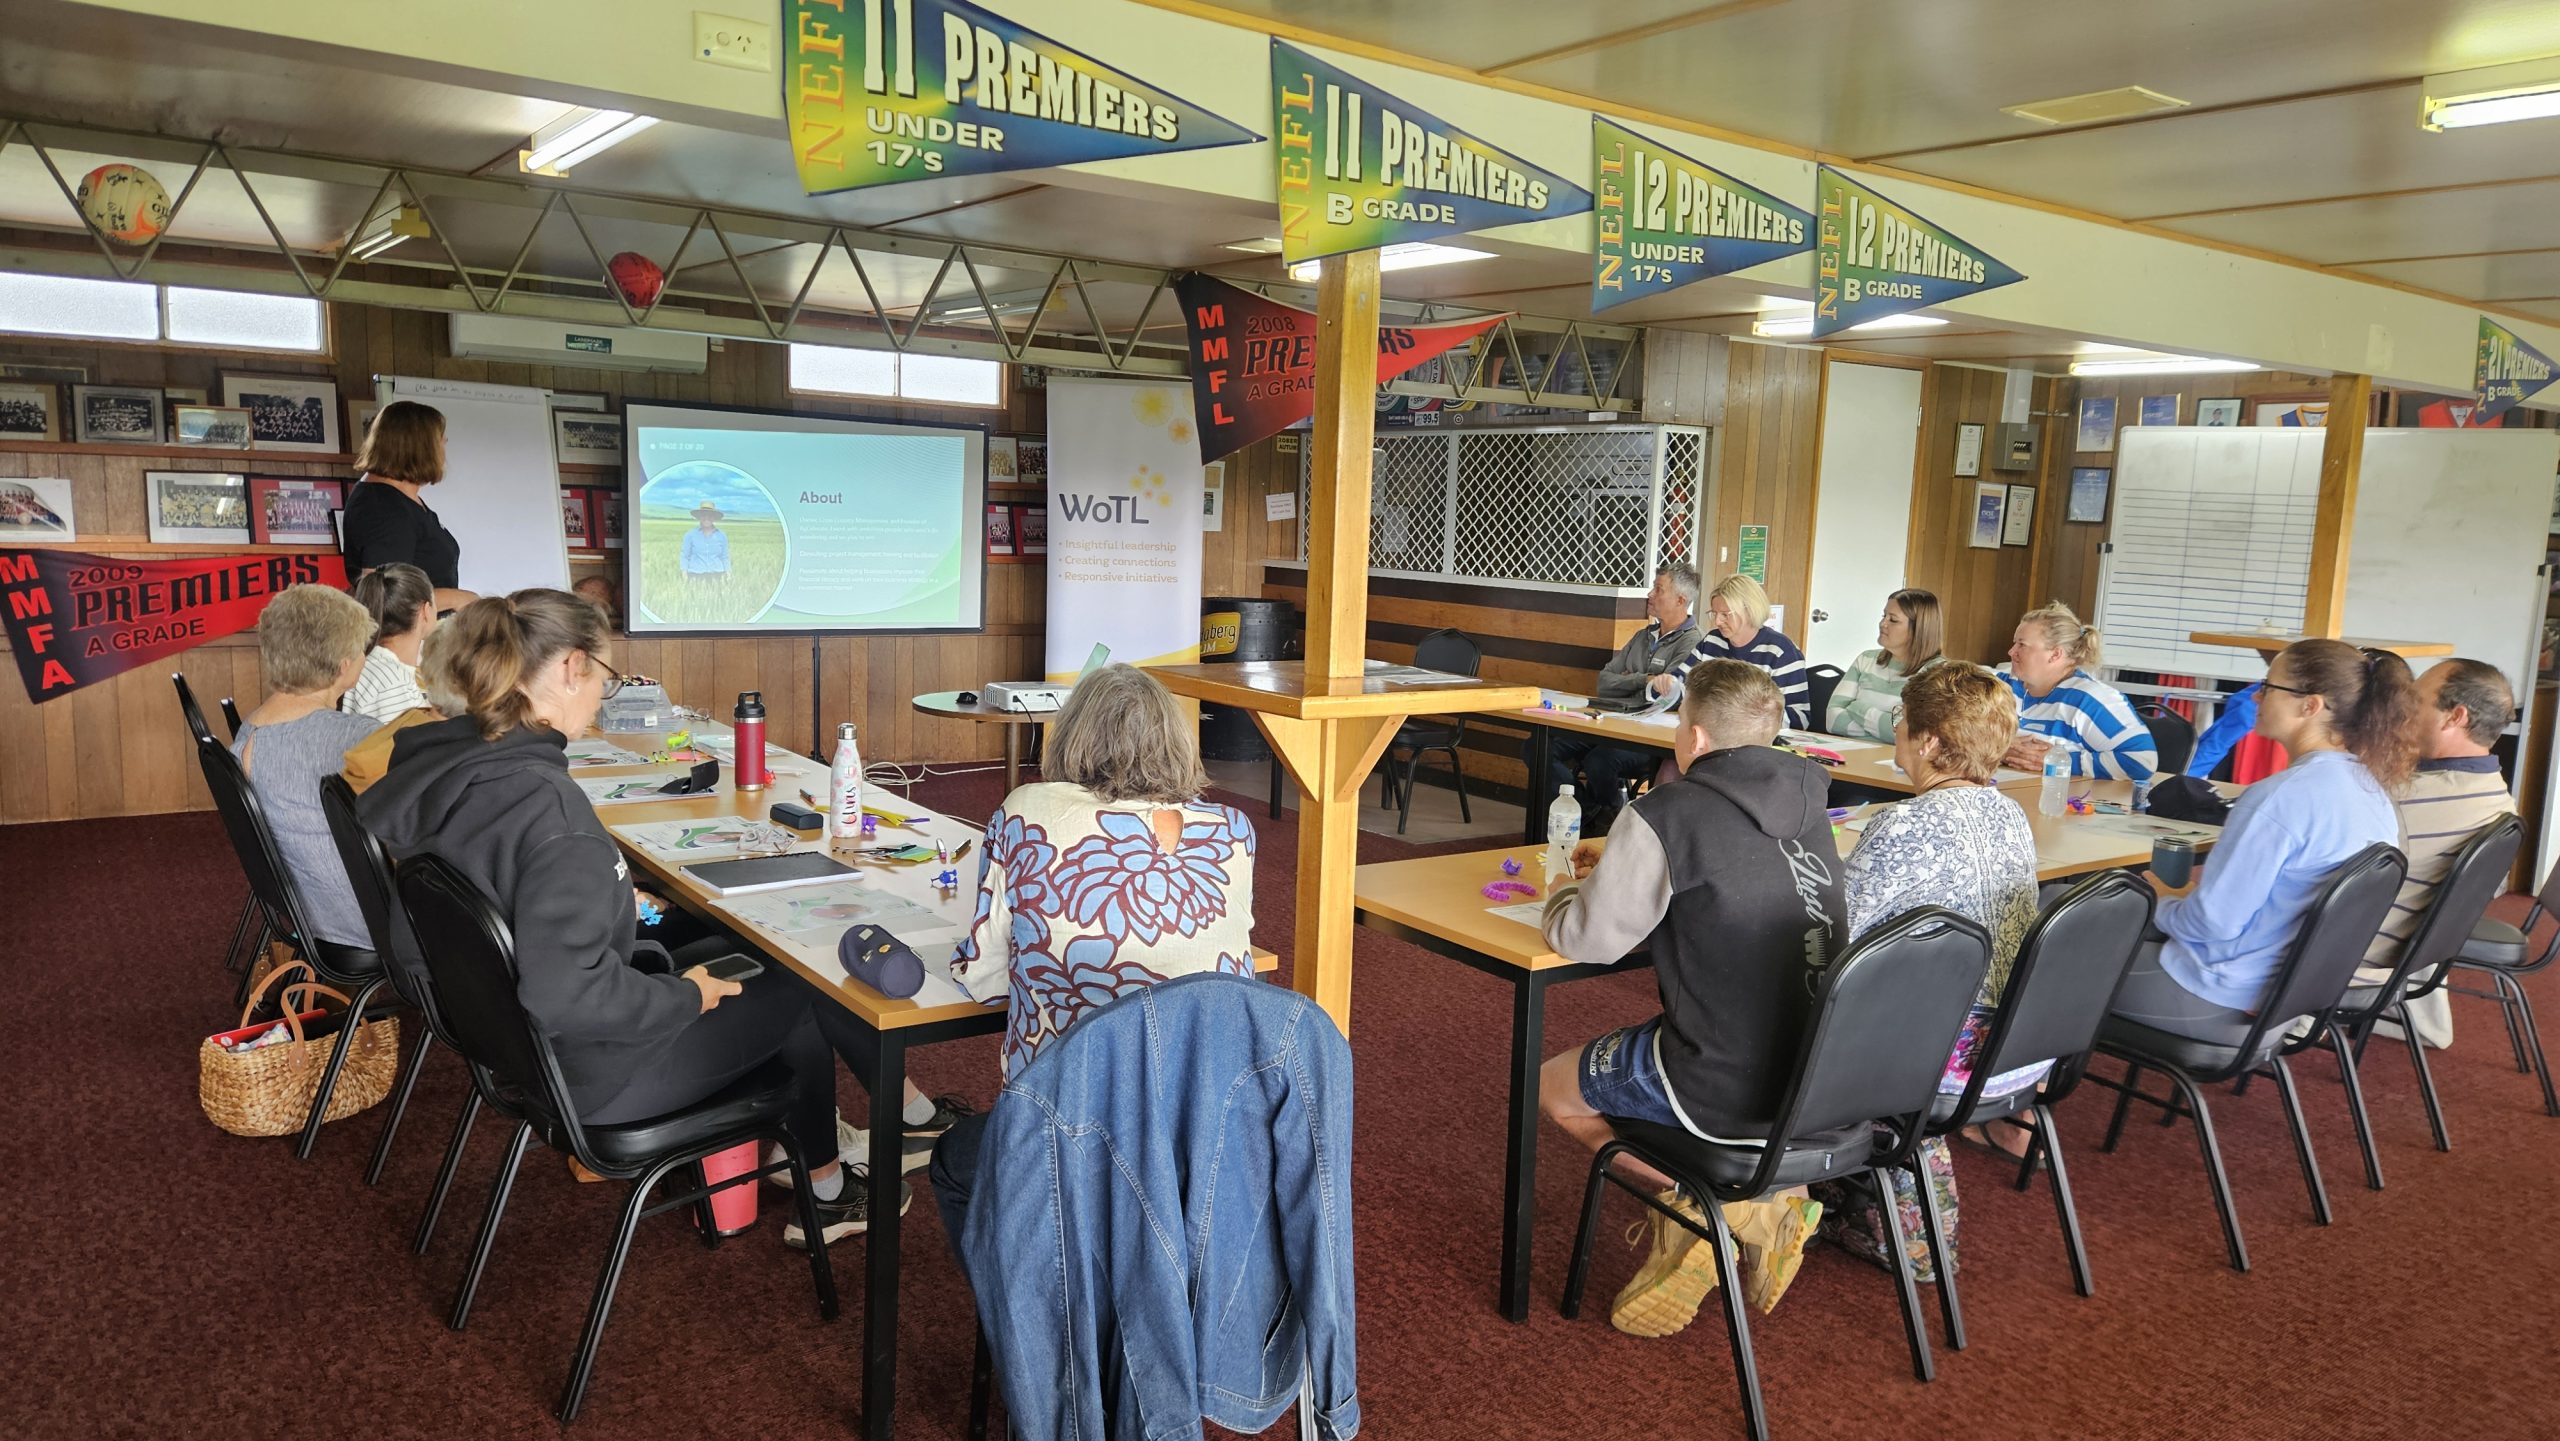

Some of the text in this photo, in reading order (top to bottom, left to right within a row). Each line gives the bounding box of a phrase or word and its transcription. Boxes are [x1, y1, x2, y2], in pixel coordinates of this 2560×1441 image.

[943, 10, 1180, 142] PREMIERS
[866, 106, 1005, 152] UNDER
[1281, 73, 1314, 247] NEFL
[1325, 83, 1550, 211] 11 PREMIERS
[1326, 192, 1457, 226] B GRADE
[1632, 150, 1805, 245] 12 PREMIERS
[1598, 142, 1625, 292] NEFL
[1630, 241, 1706, 265] UNDER
[1817, 187, 1844, 321] NEFL
[1846, 196, 1986, 285] 12 PREMIERS
[1844, 277, 1923, 302] B GRADE
[1246, 316, 1297, 335] 2008
[2502, 343, 2551, 380] PREMIERS
[1246, 374, 1316, 402] A GRAD
[2487, 385, 2522, 402] B GRADE
[799, 490, 843, 504] About
[1058, 493, 1150, 525] WoTL
[1064, 540, 1177, 554] Insightful leadership
[1064, 555, 1177, 568] Creating connections
[68, 564, 145, 589] 2009
[69, 553, 320, 631] PREMIERS
[1064, 571, 1179, 583] Responsive initiatives
[85, 617, 207, 658] A GRADE
